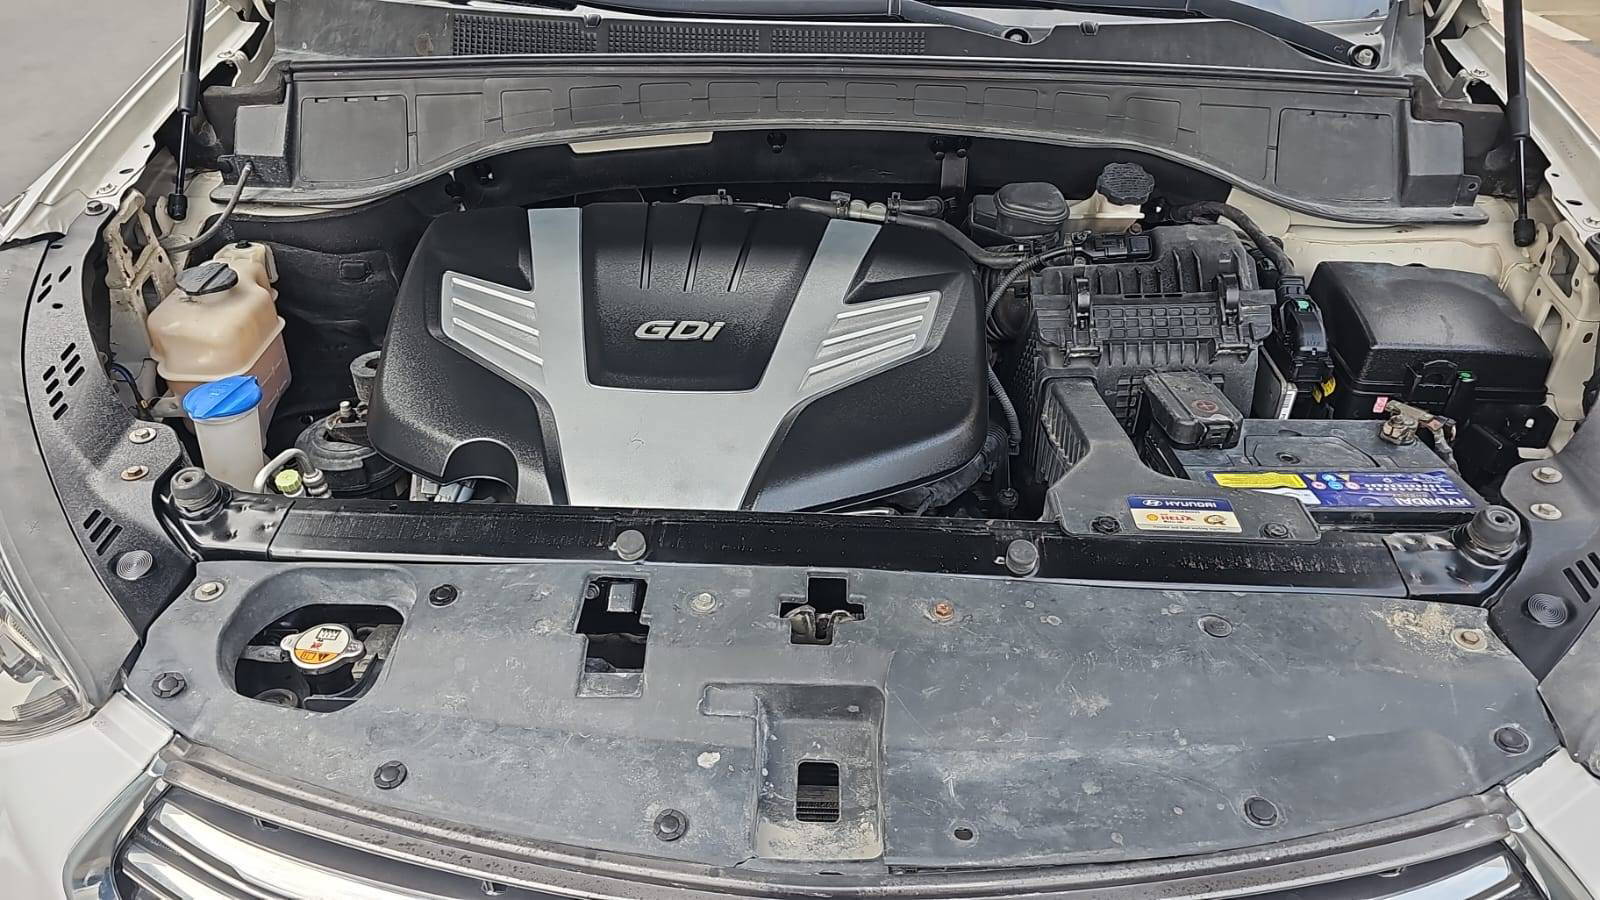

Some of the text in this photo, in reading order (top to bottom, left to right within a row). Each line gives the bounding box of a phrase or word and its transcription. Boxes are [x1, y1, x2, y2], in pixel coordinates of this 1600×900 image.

[634, 320, 725, 341] GDi
[1164, 500, 1217, 508] HYUNDAI
[1394, 497, 1472, 506] HYUNDAI
